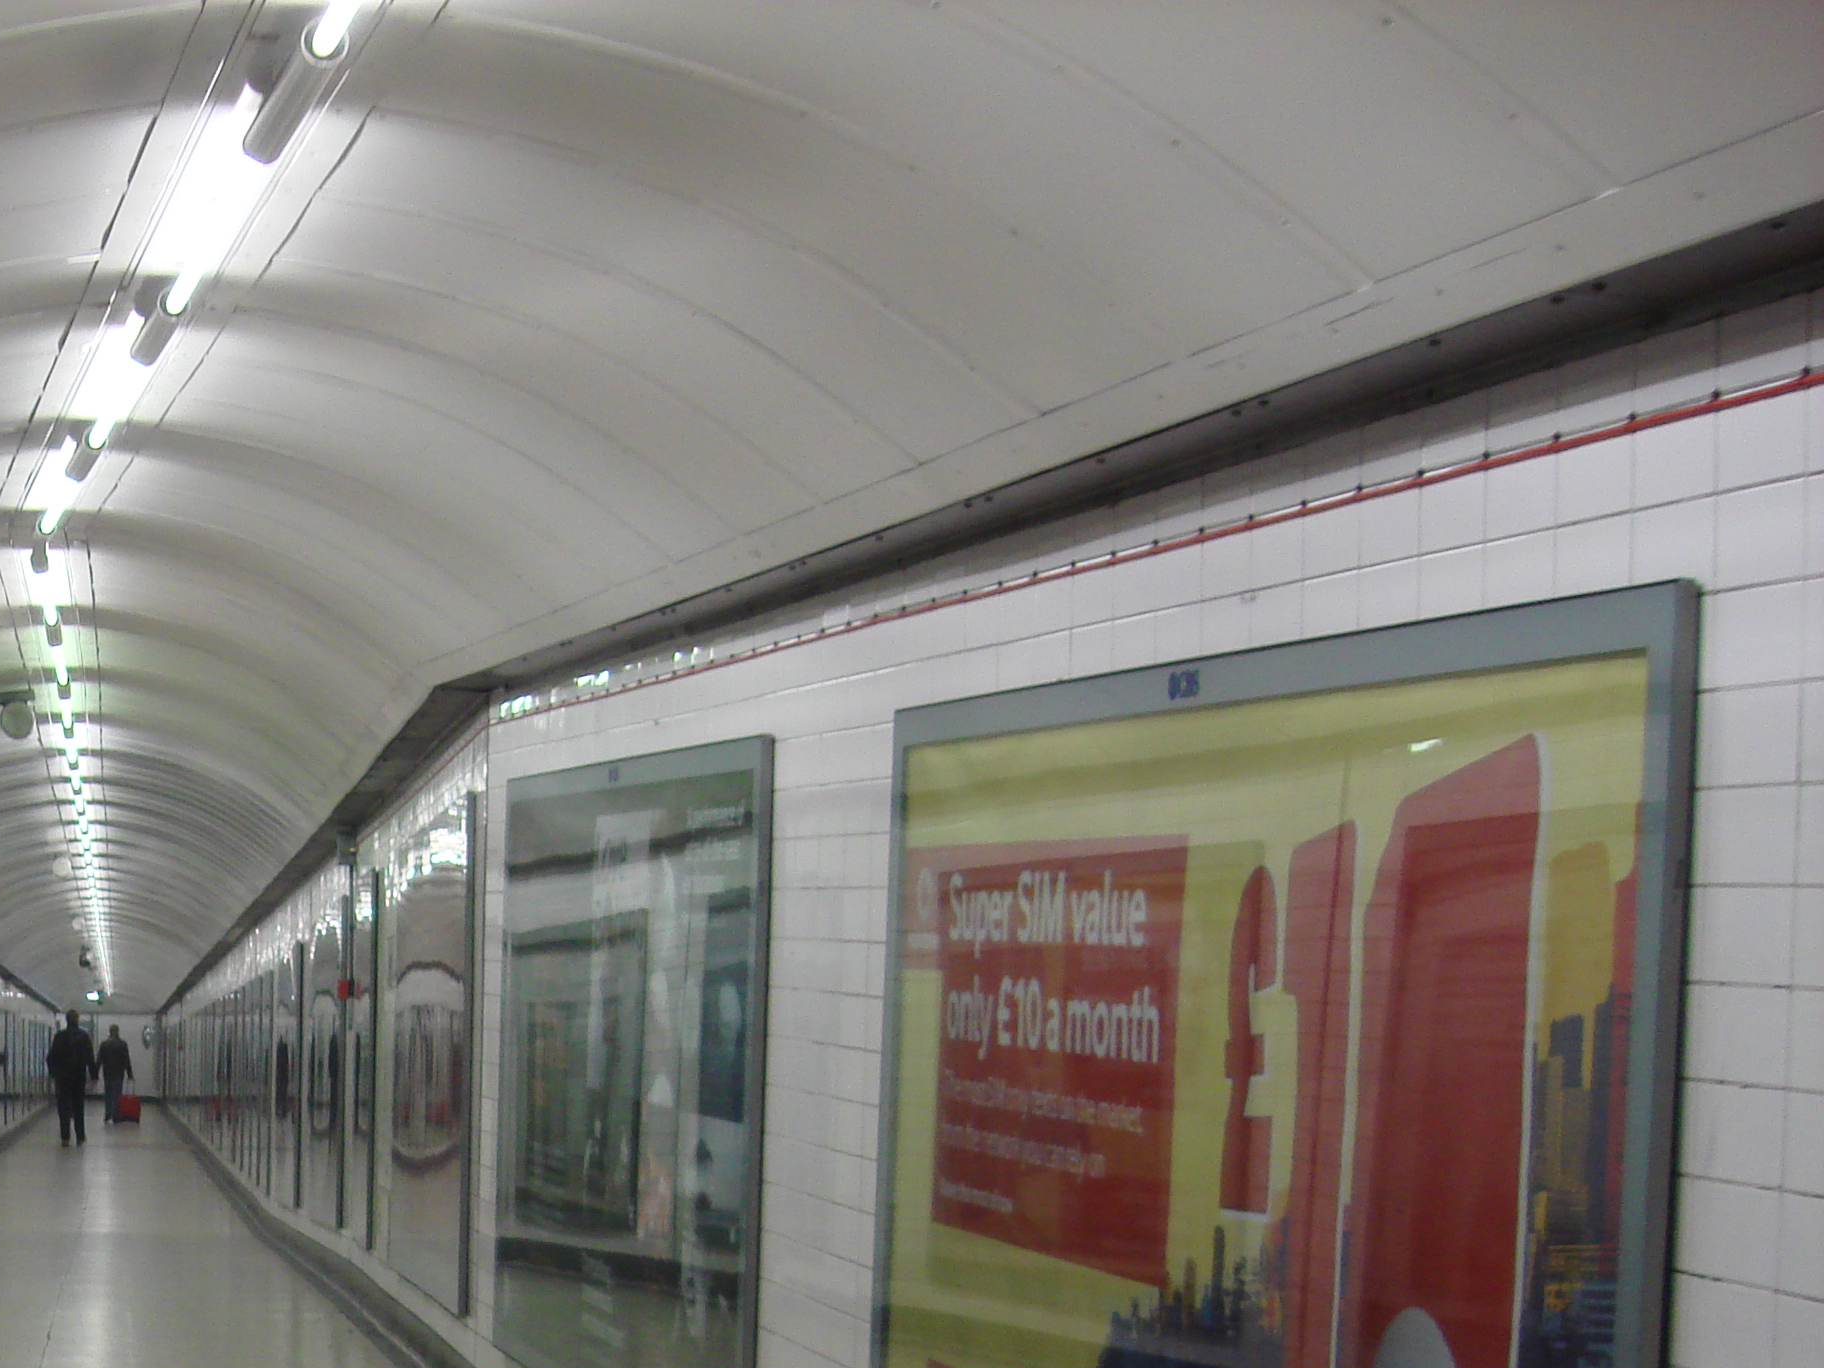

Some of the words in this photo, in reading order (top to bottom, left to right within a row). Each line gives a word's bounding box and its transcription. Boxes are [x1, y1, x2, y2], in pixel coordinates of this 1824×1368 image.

[948, 872, 1014, 959] Super
[1017, 870, 1066, 945] SIM
[1070, 869, 1147, 947] value
[946, 973, 995, 1061] only
[997, 974, 1043, 1049] £10
[1045, 997, 1062, 1053] a
[1065, 985, 1160, 1065] month
